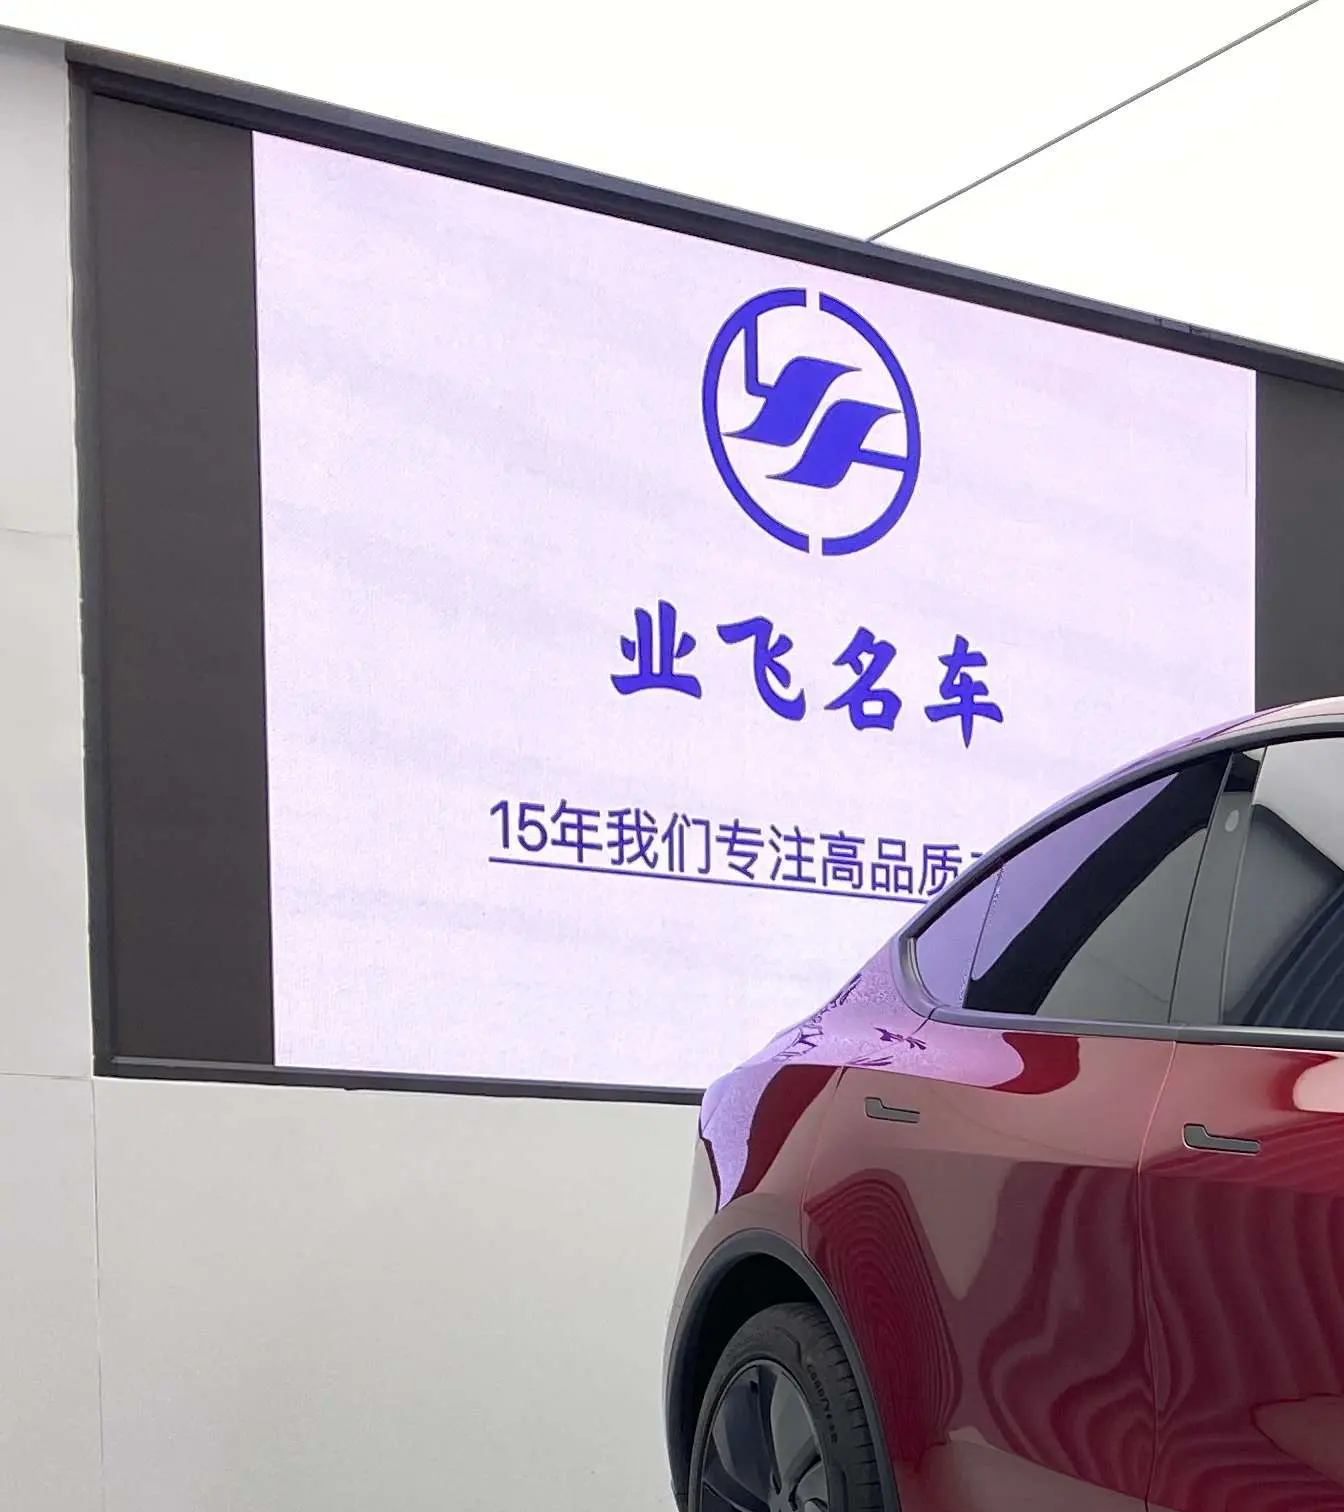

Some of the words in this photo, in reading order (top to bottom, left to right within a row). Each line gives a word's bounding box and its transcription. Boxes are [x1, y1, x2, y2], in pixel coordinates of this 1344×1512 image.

[610, 600, 1004, 749] 业飞名车
[490, 799, 983, 896] 15年我们专注高品质
